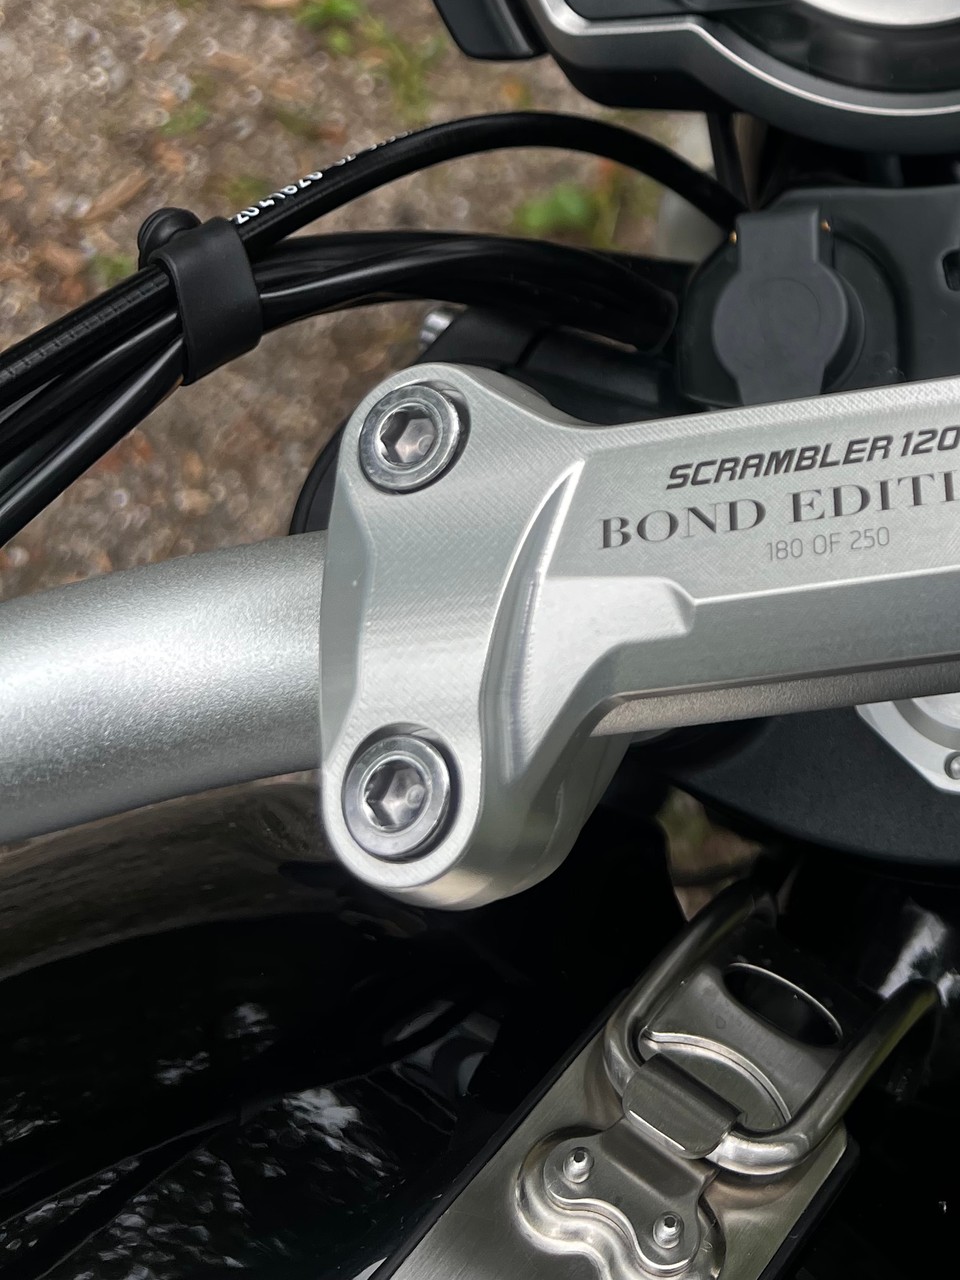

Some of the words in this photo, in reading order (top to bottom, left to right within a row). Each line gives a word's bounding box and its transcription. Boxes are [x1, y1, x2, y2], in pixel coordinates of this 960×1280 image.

[665, 434, 895, 490] SCRAMBLER
[598, 497, 768, 550] BOND
[766, 537, 804, 562] 180
[812, 532, 841, 557] OF
[849, 525, 891, 552] 250
